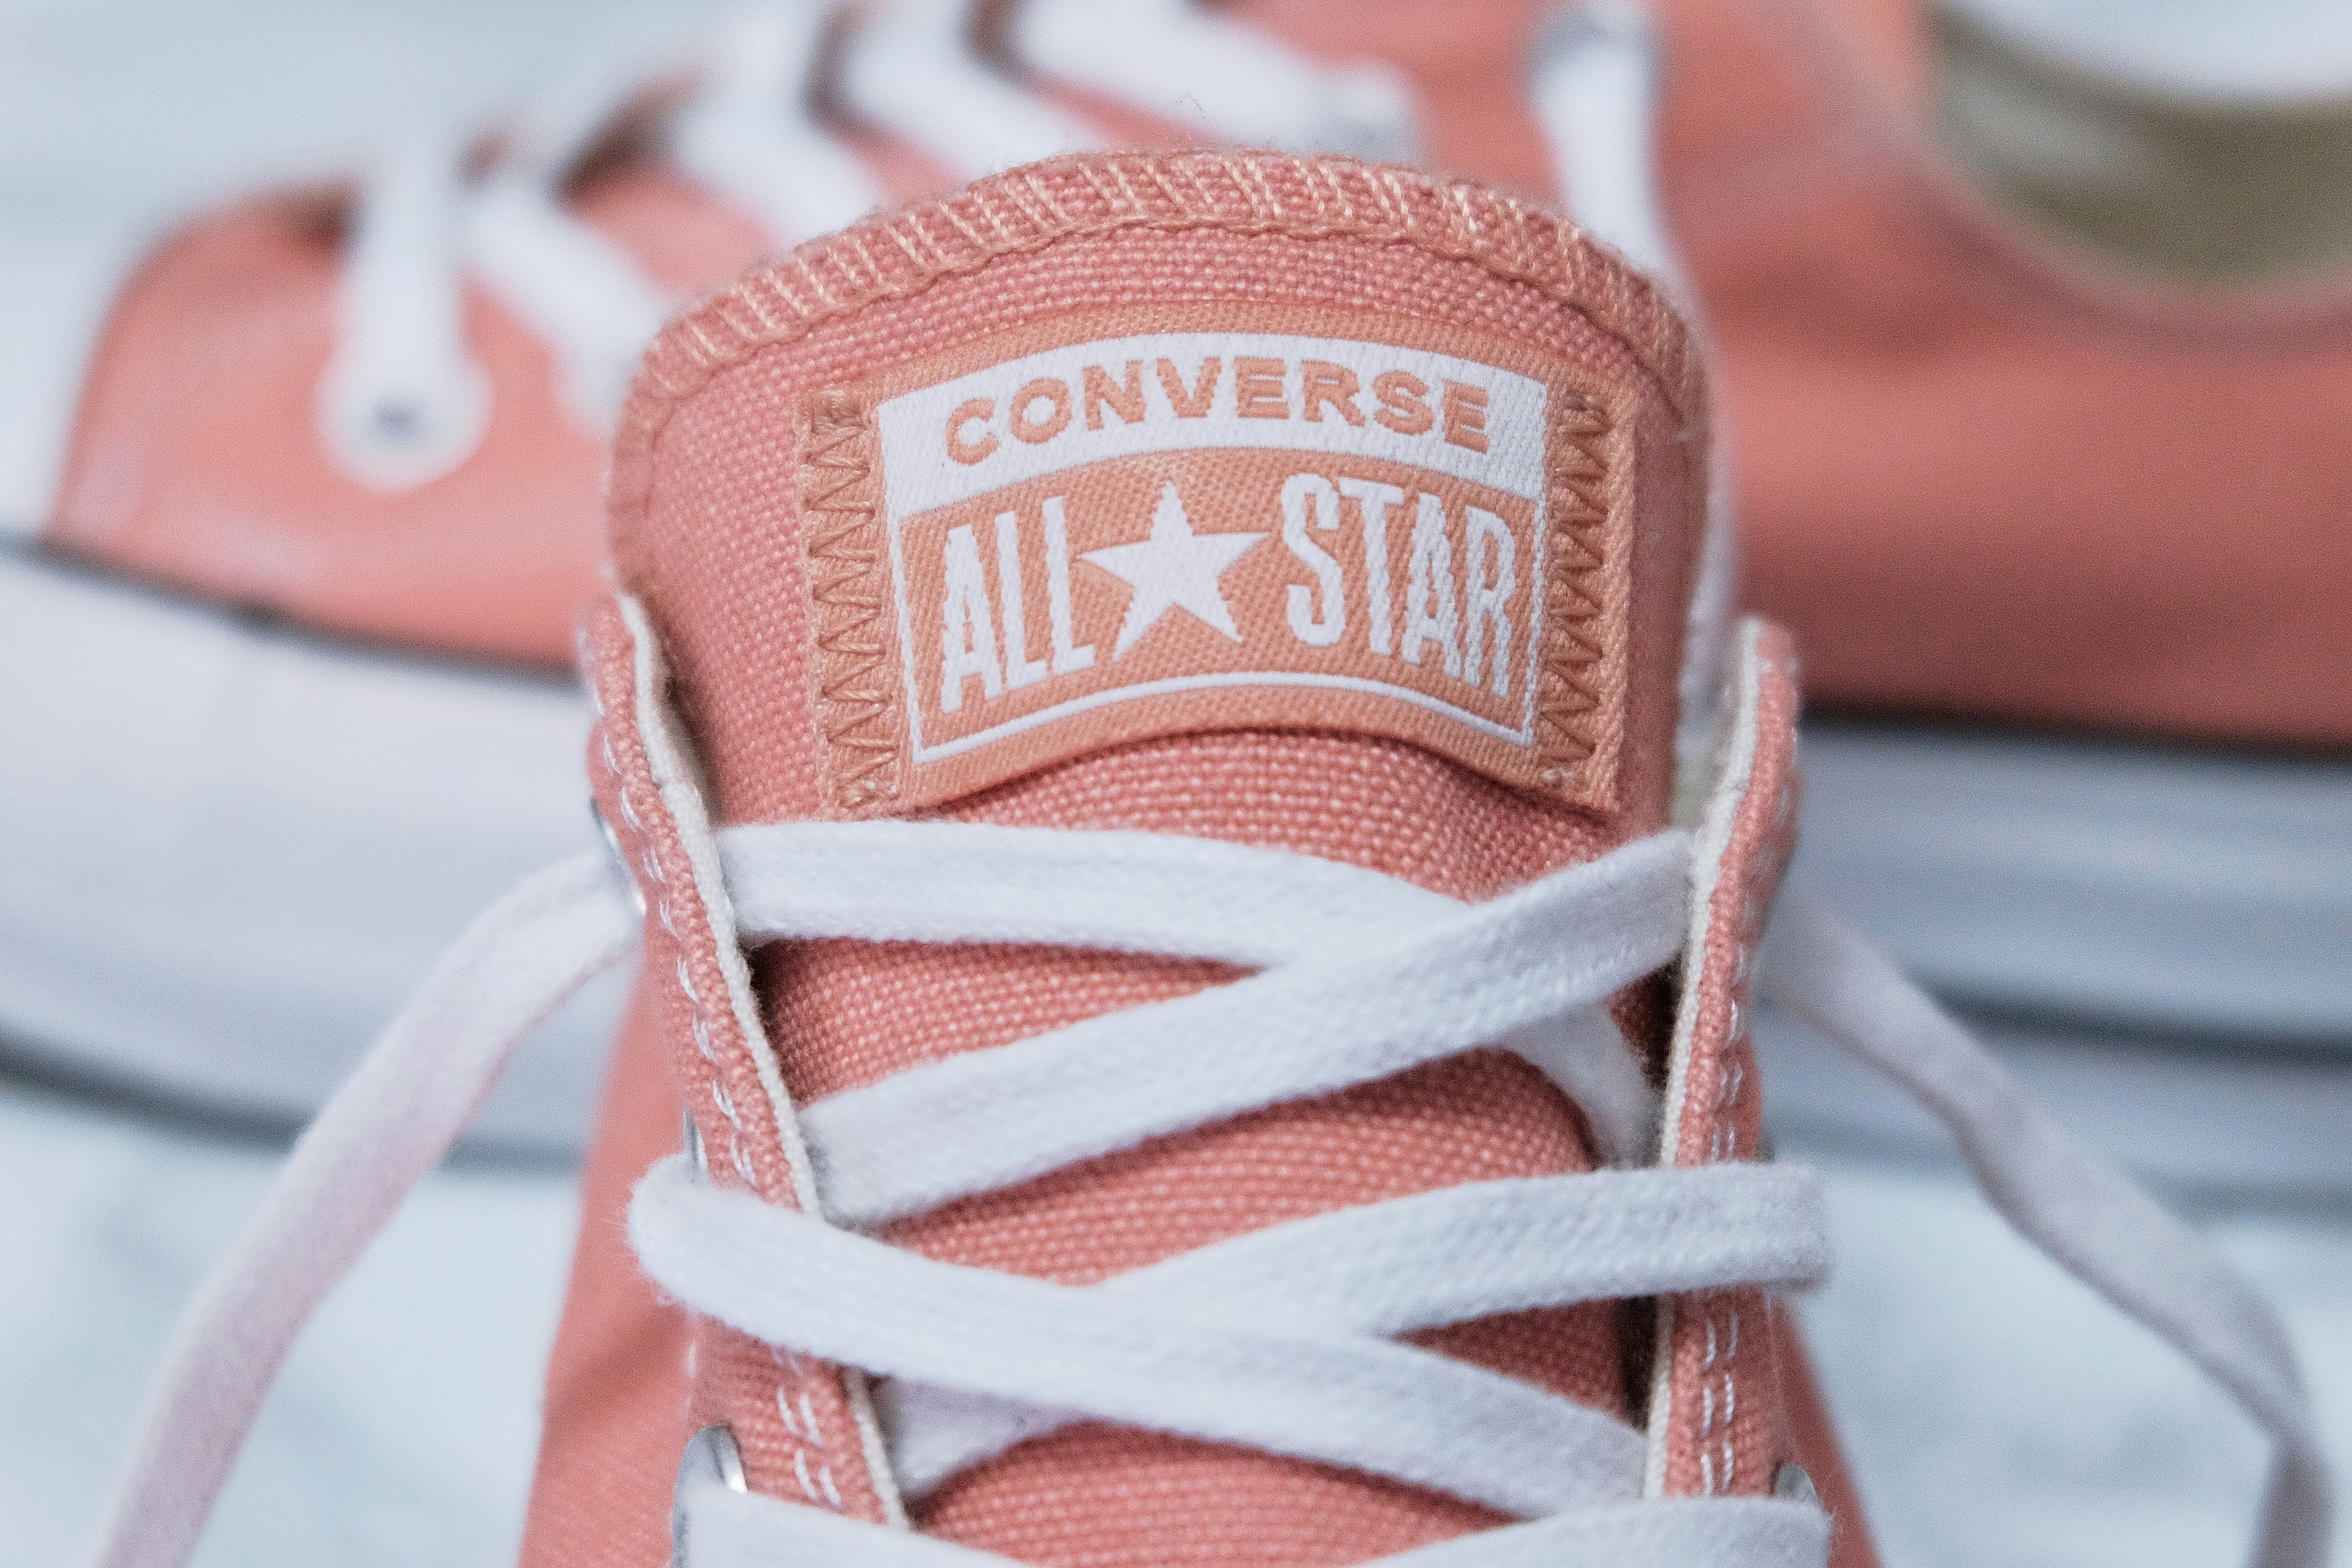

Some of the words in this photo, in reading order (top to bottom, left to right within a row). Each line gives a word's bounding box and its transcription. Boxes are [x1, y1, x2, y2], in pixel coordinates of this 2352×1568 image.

[944, 355, 1491, 465] CONVERSE
[940, 495, 1095, 713] ALL
[1280, 472, 1517, 698] STAR
